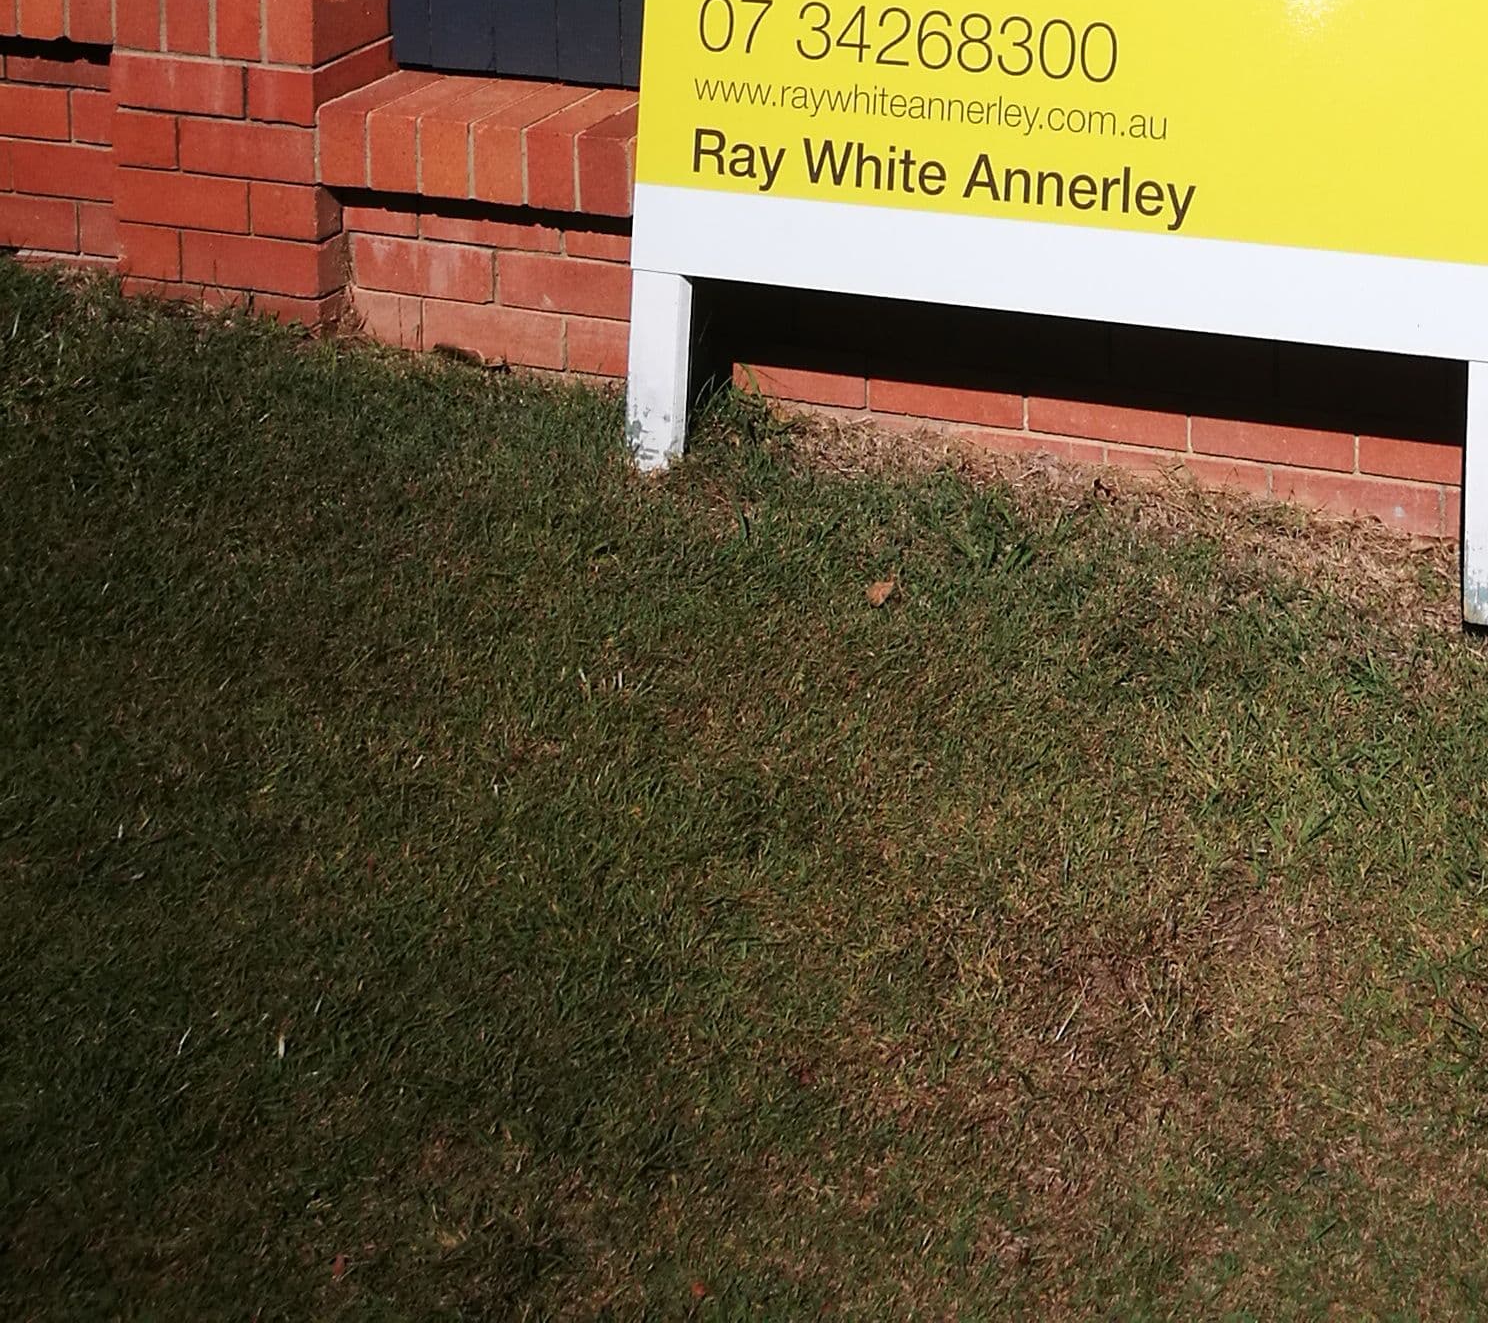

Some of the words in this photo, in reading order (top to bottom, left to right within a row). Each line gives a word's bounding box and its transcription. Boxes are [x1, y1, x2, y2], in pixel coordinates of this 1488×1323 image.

[796, 1, 1118, 83] 34268300
[694, 78, 1167, 140] www.raywhiteannerley.com.au
[693, 127, 787, 192] Ray
[803, 137, 947, 196] White
[962, 153, 1197, 231] Annerley
